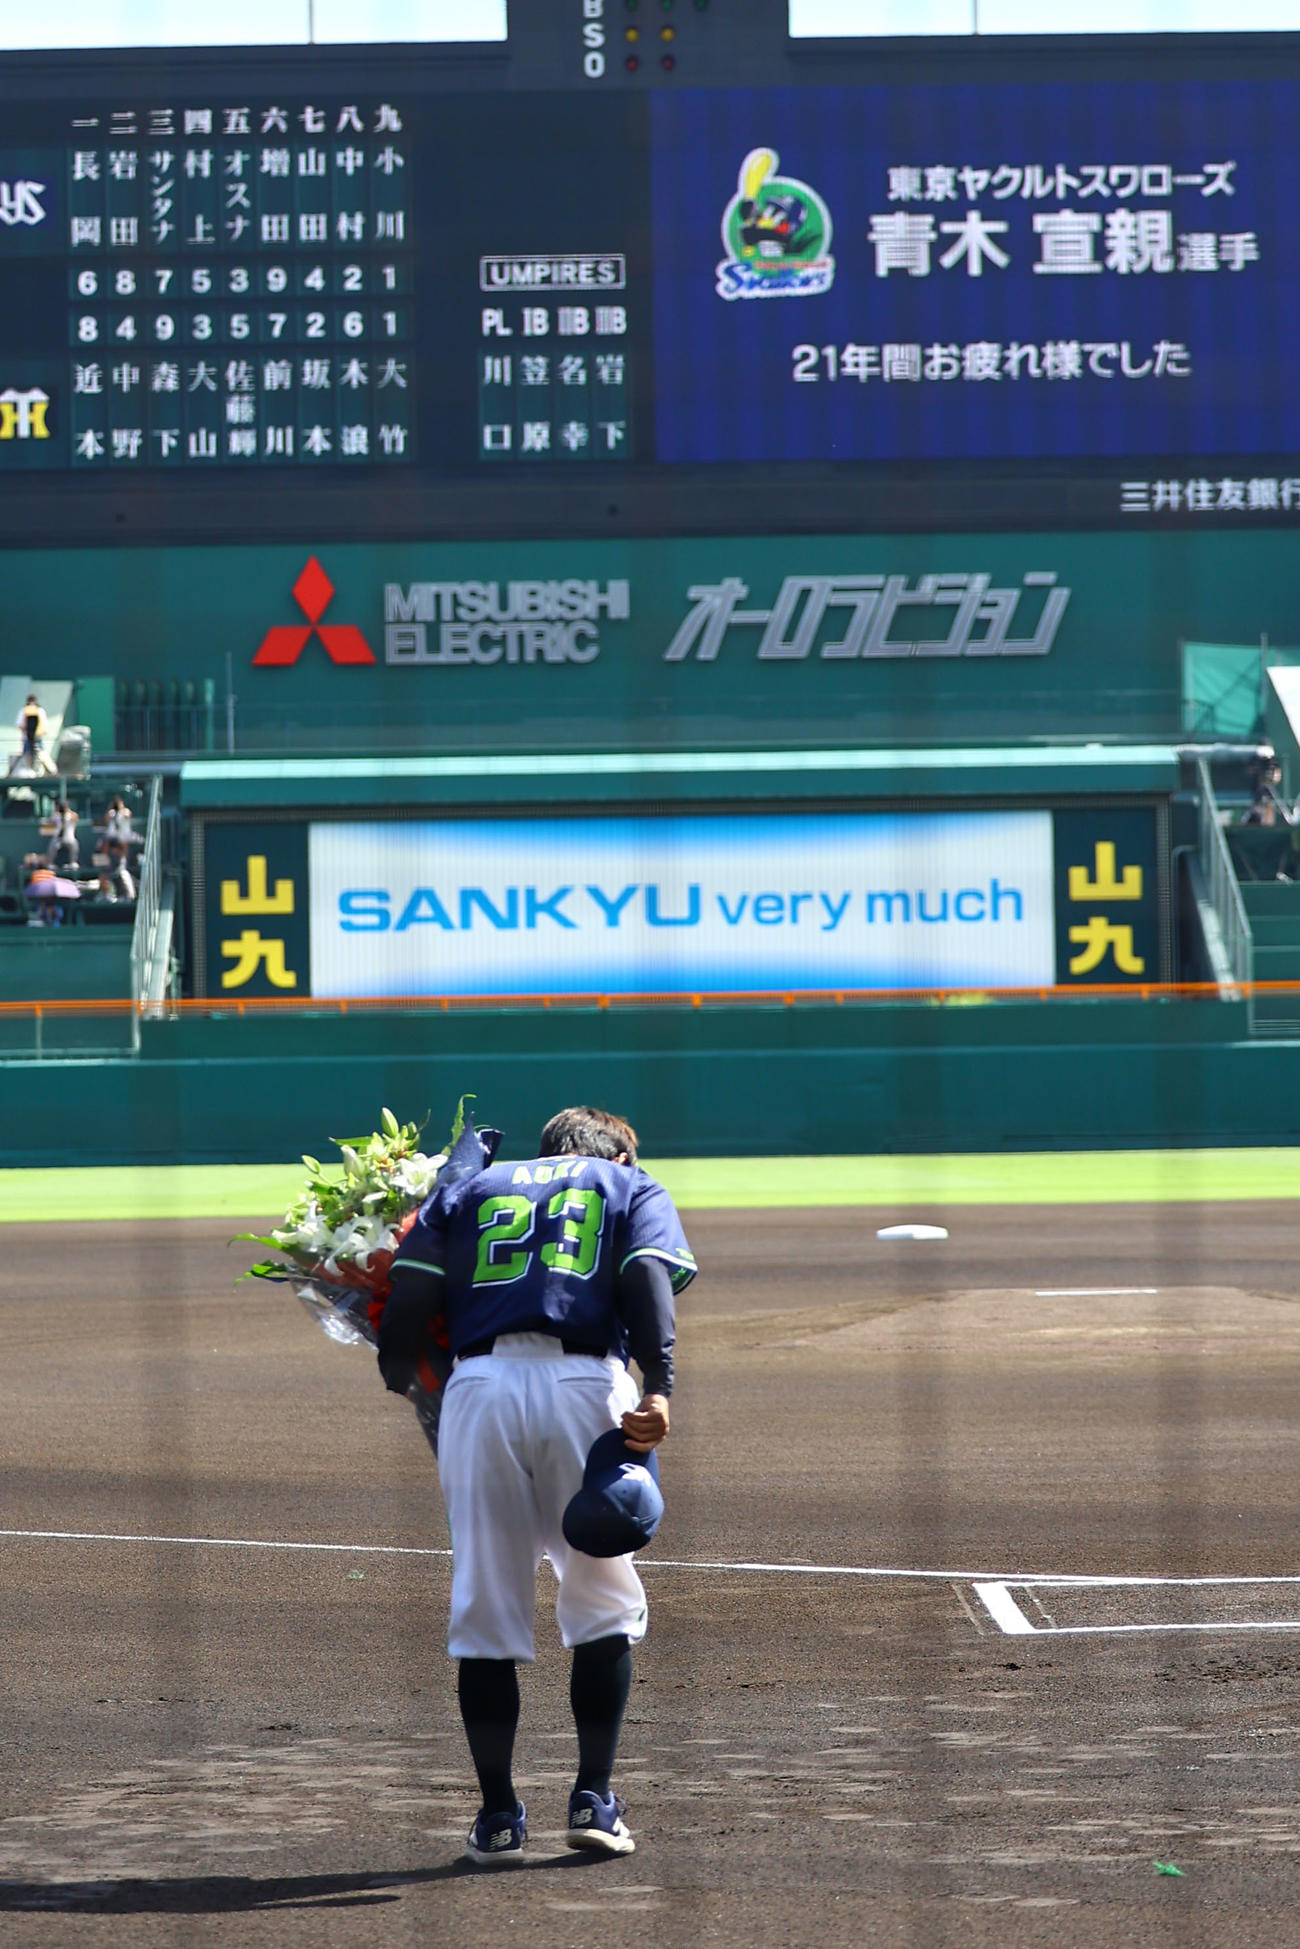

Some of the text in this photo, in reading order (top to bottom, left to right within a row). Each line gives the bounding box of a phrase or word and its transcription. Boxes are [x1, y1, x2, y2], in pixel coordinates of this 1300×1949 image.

[583, 22, 606, 48] S
[584, 51, 605, 78] O
[888, 160, 1237, 202] 東京ヤクルトスワローズ
[77, 266, 397, 296] 6 8 7 5 3 9 4 2 1
[490, 262, 617, 285] UMPIRES
[78, 311, 397, 342] 8 4 9 3 5 7 2 6 1
[482, 308, 512, 336] PL
[792, 340, 1192, 383] 21年間お疲れ様でした
[385, 579, 630, 622] MITSUBISHI
[385, 620, 599, 665] ELECTRIC
[338, 878, 1024, 933] SANKYU very much
[472, 1187, 608, 1288] 23
